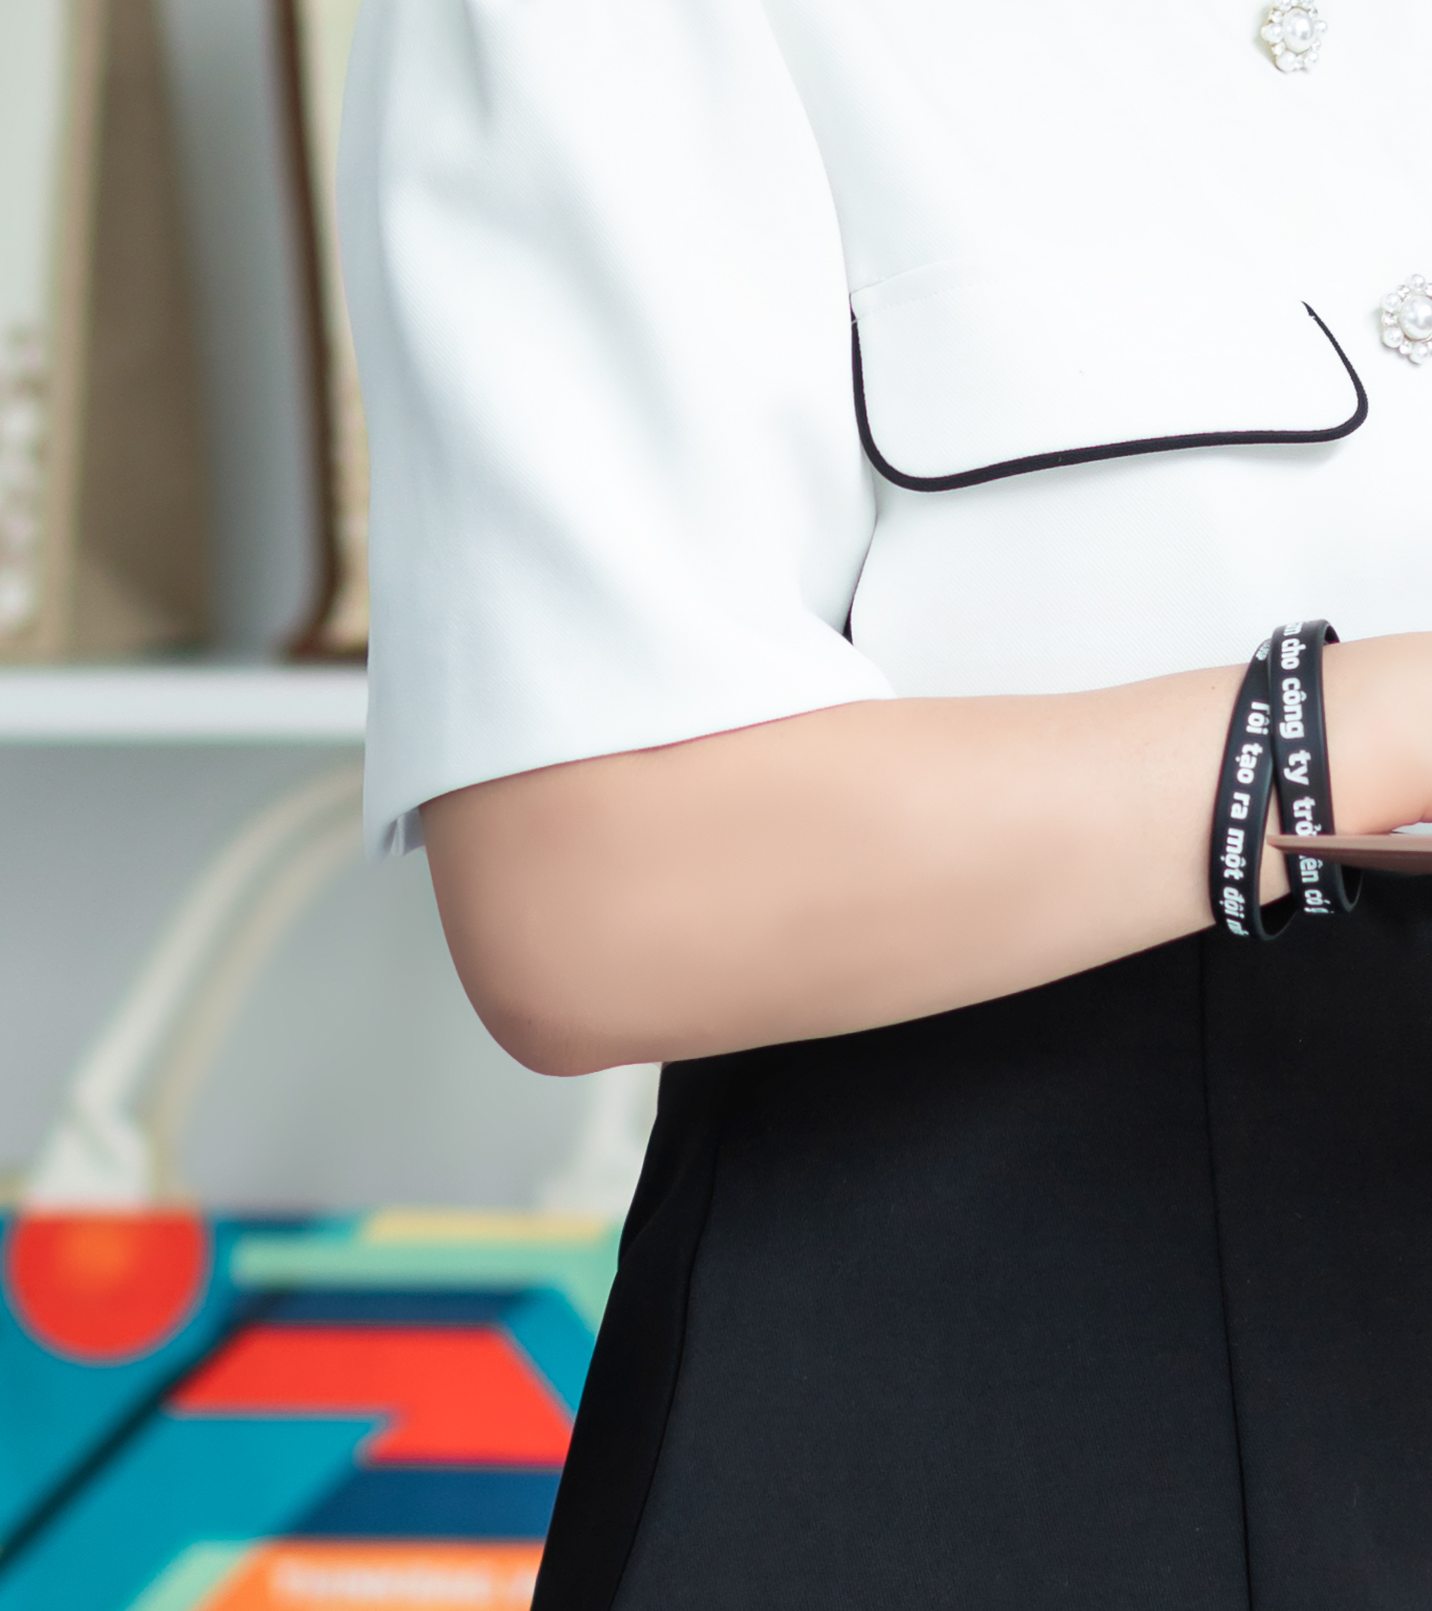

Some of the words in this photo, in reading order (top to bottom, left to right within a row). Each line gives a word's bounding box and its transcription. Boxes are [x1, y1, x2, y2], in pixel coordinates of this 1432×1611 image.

[1280, 638, 1307, 671] cho
[1246, 701, 1270, 735] Tôi
[1278, 676, 1308, 740] công
[1235, 743, 1263, 785] tạo
[1283, 748, 1312, 786] ty
[1230, 792, 1251, 820] ra
[1220, 827, 1247, 881] một
[1299, 855, 1324, 883] ên
